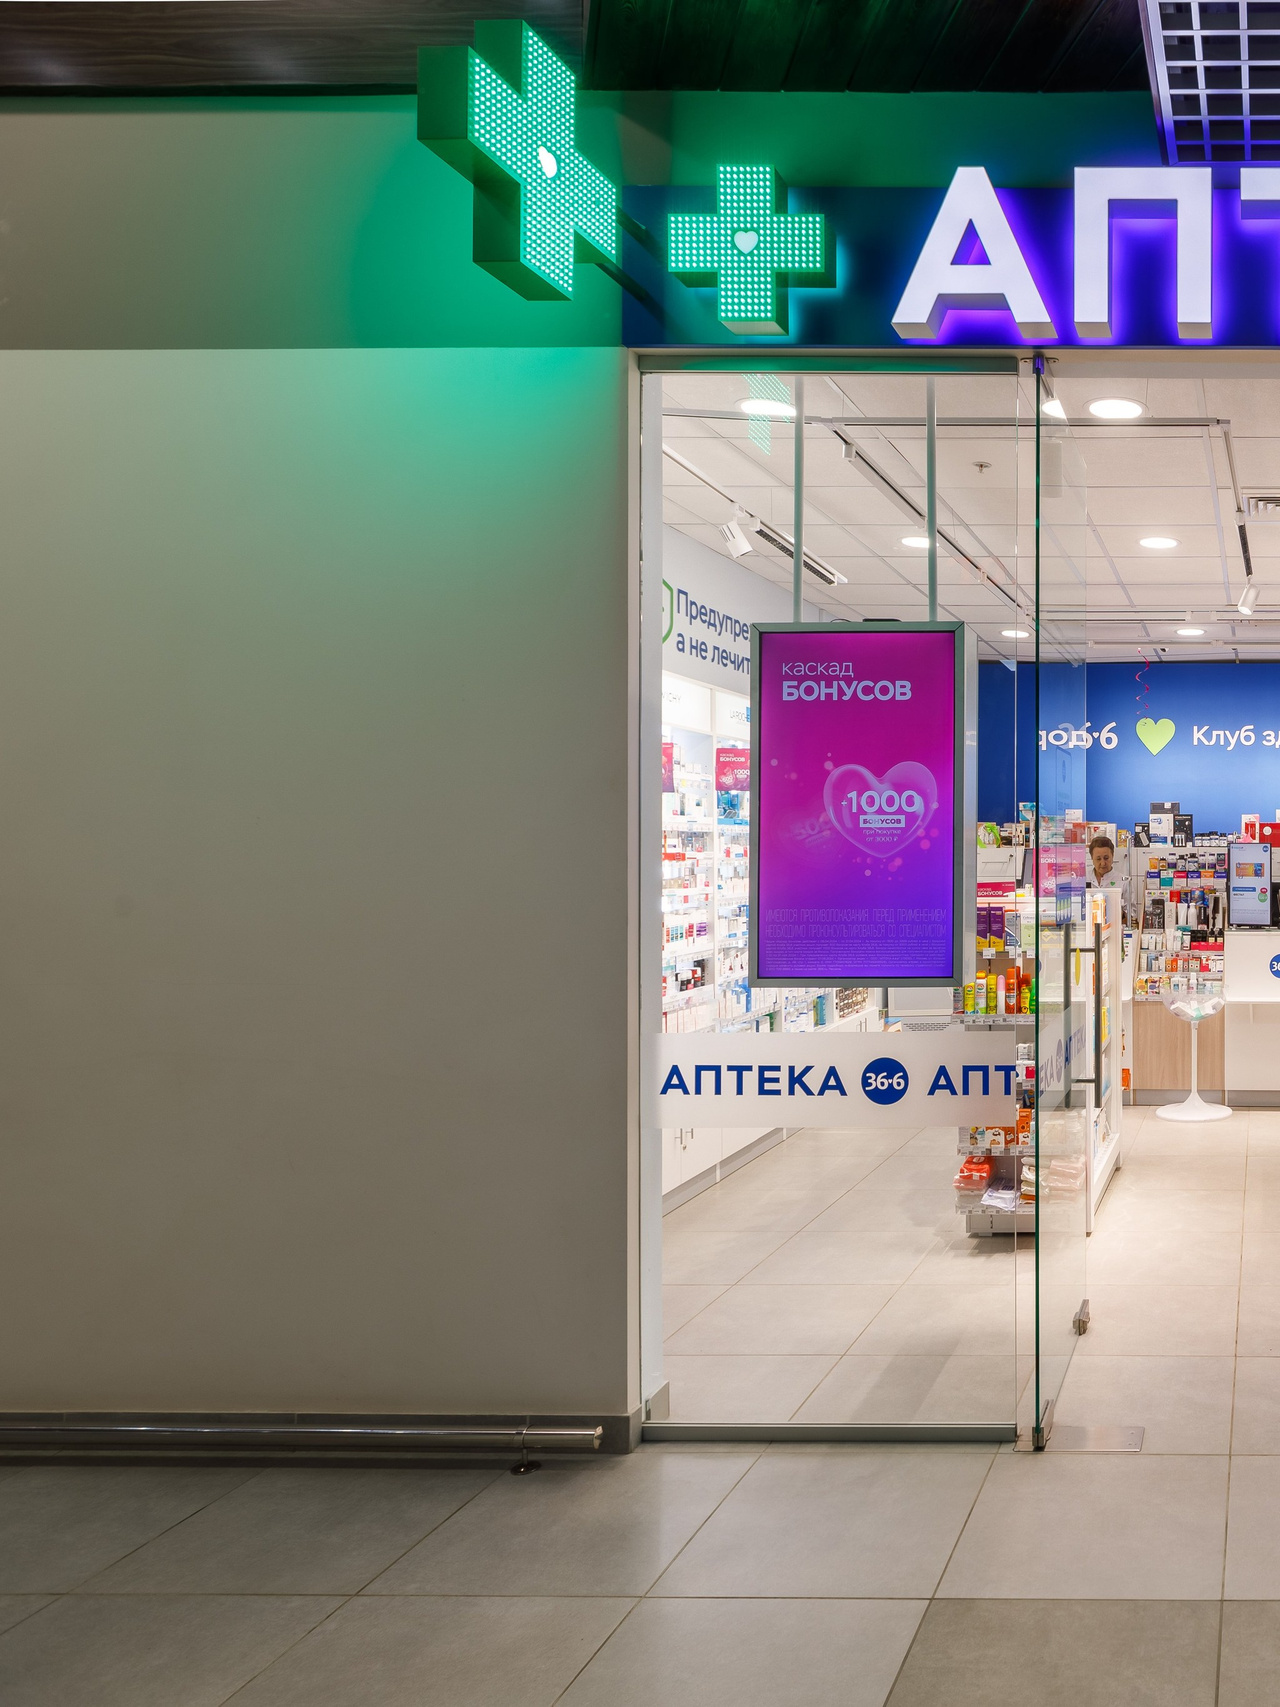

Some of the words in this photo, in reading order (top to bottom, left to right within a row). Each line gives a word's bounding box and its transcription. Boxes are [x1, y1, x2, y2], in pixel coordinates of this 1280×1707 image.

[676, 632, 685, 653] а
[689, 636, 708, 660] не
[782, 662, 854, 678] каскад
[782, 681, 912, 701] БОНУСОВ
[1193, 725, 1257, 751] Клуб
[660, 1065, 848, 1096] АПТЕКА
[927, 1065, 1016, 1096] АПТ
